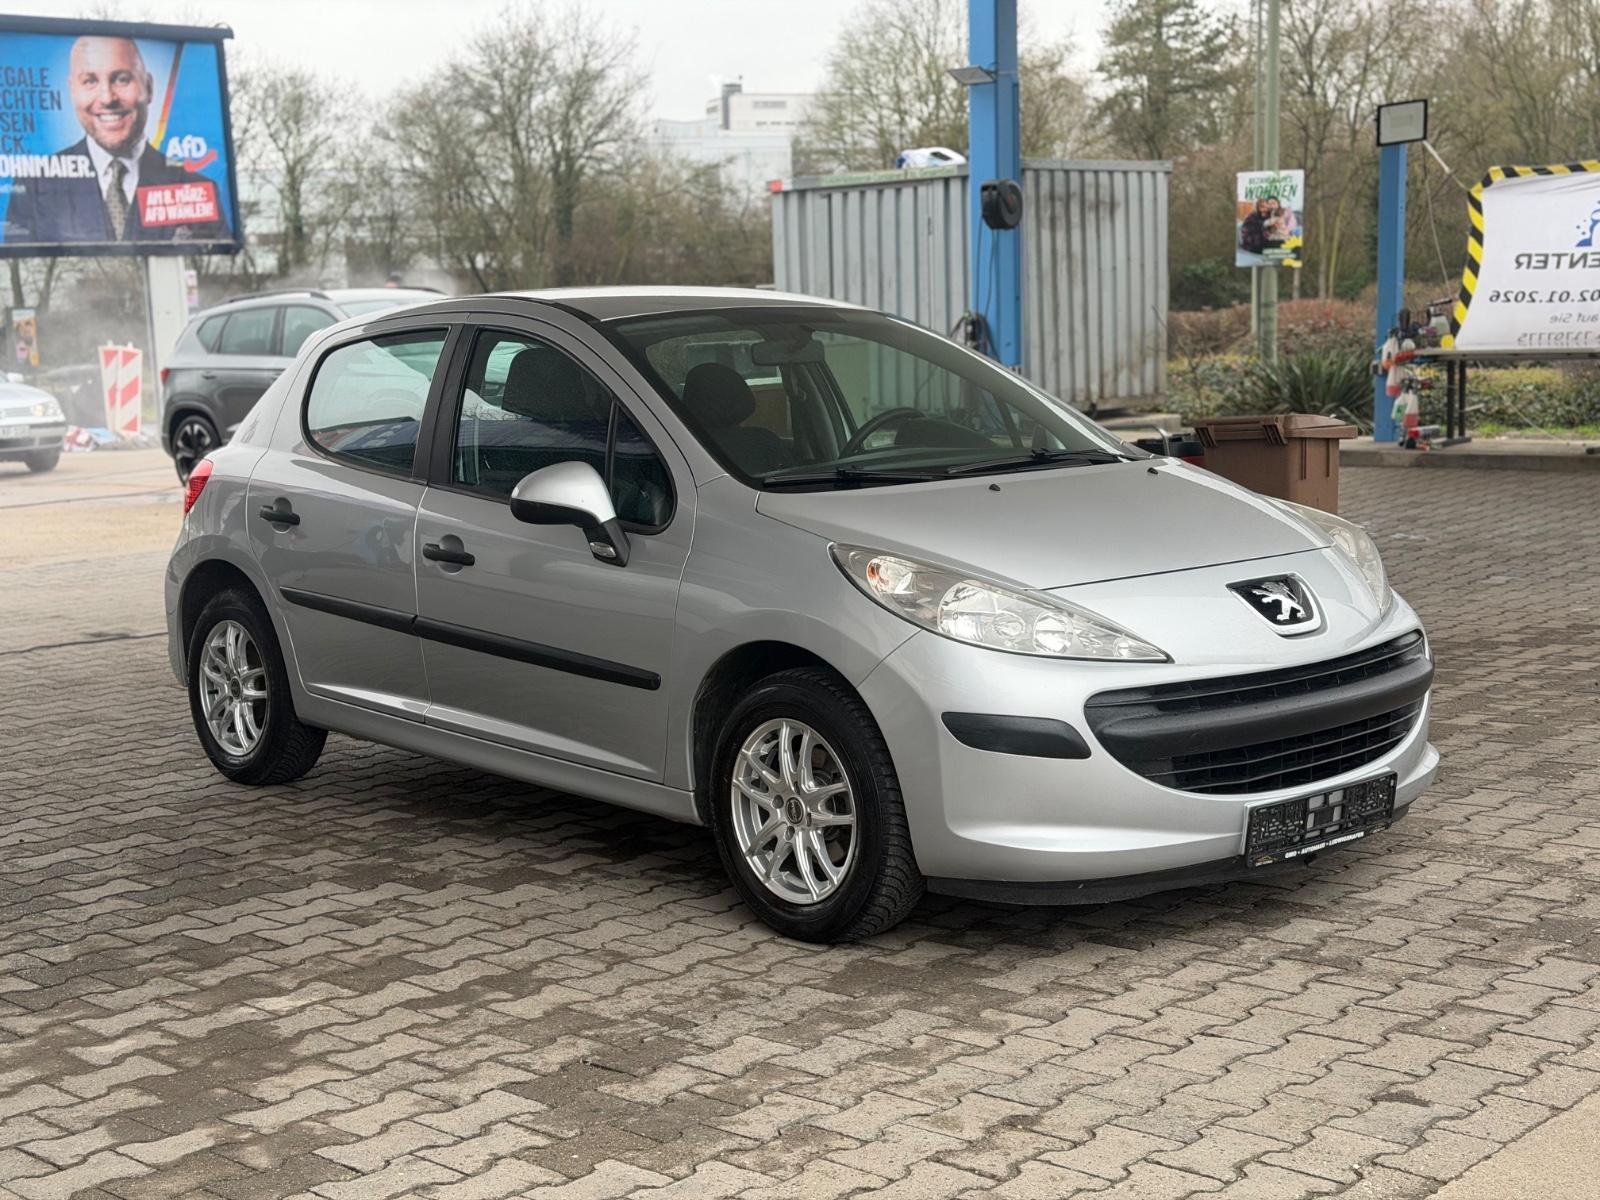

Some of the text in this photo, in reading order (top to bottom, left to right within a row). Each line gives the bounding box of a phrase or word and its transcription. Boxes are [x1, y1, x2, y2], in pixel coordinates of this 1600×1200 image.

[0, 65, 50, 88] GALE
[0, 89, 62, 111] CHTEN
[166, 133, 208, 158] AfD
[1244, 183, 1298, 201] WOHNEN
